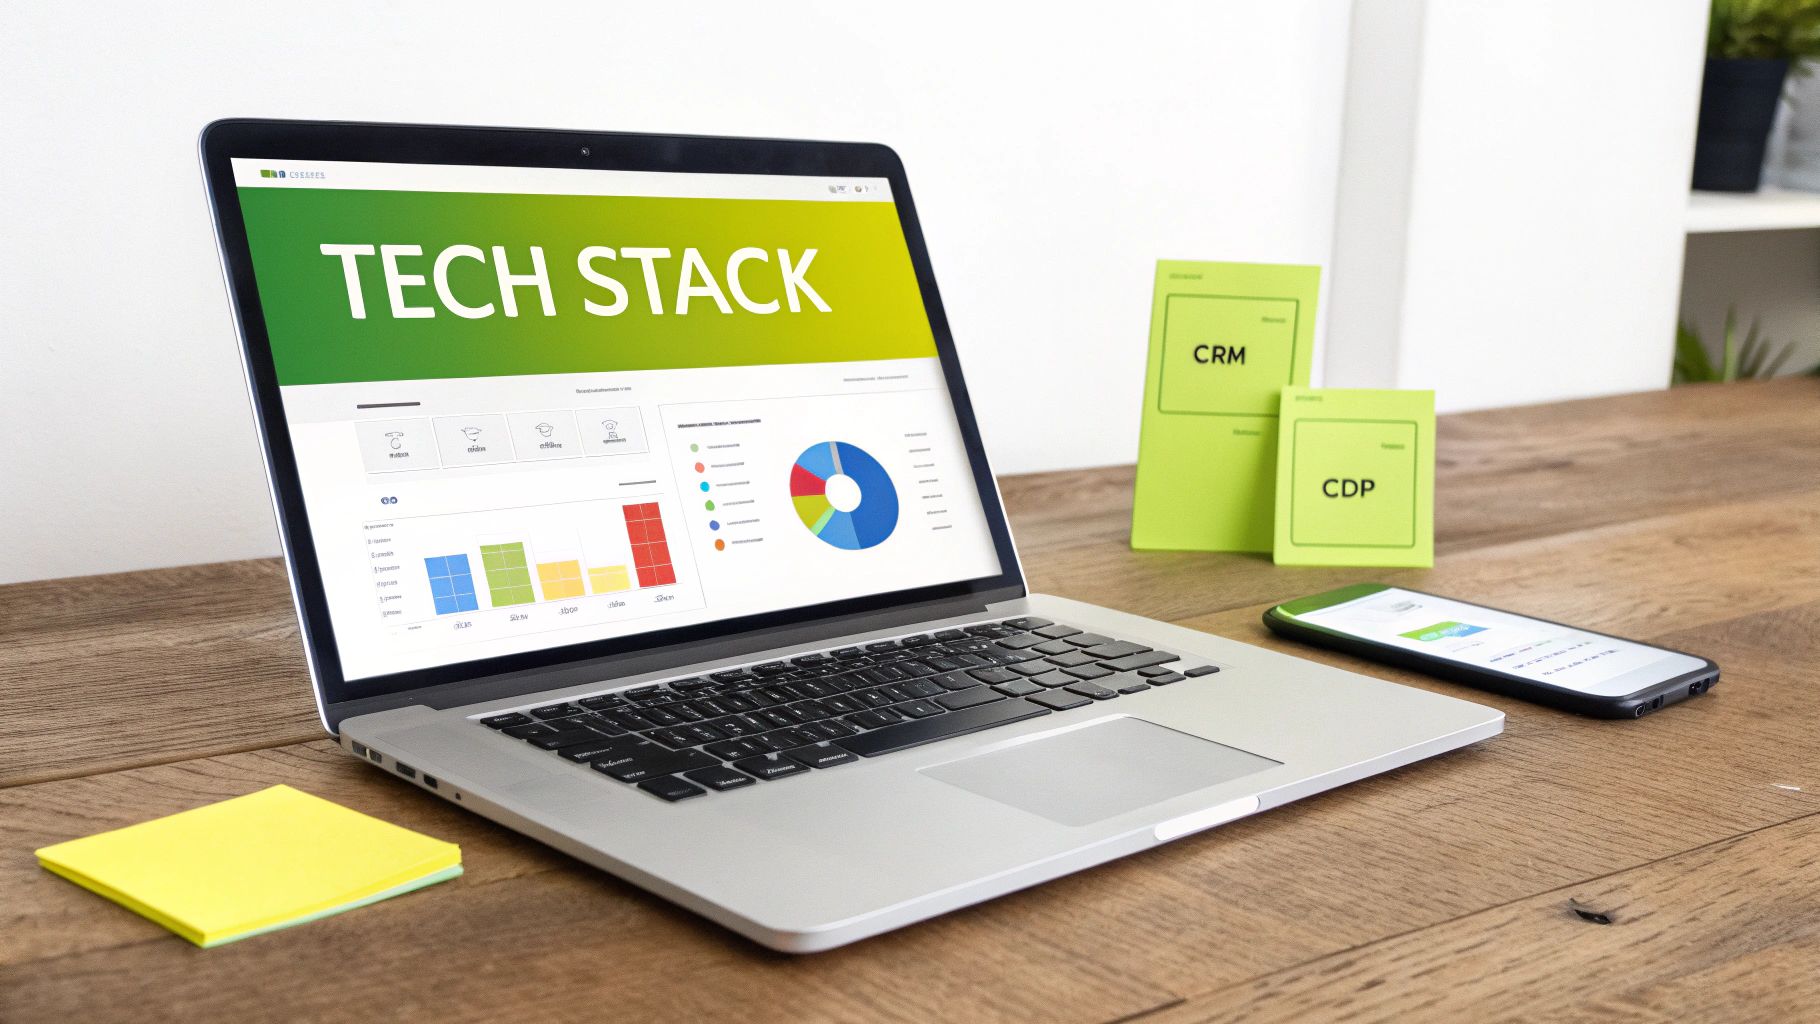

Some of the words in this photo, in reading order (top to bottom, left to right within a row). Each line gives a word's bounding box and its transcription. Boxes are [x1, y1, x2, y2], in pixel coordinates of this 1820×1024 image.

[319, 243, 557, 320] TECH
[577, 245, 833, 317] STACK
[1193, 344, 1246, 366] CRM
[1322, 478, 1376, 498] CDP
